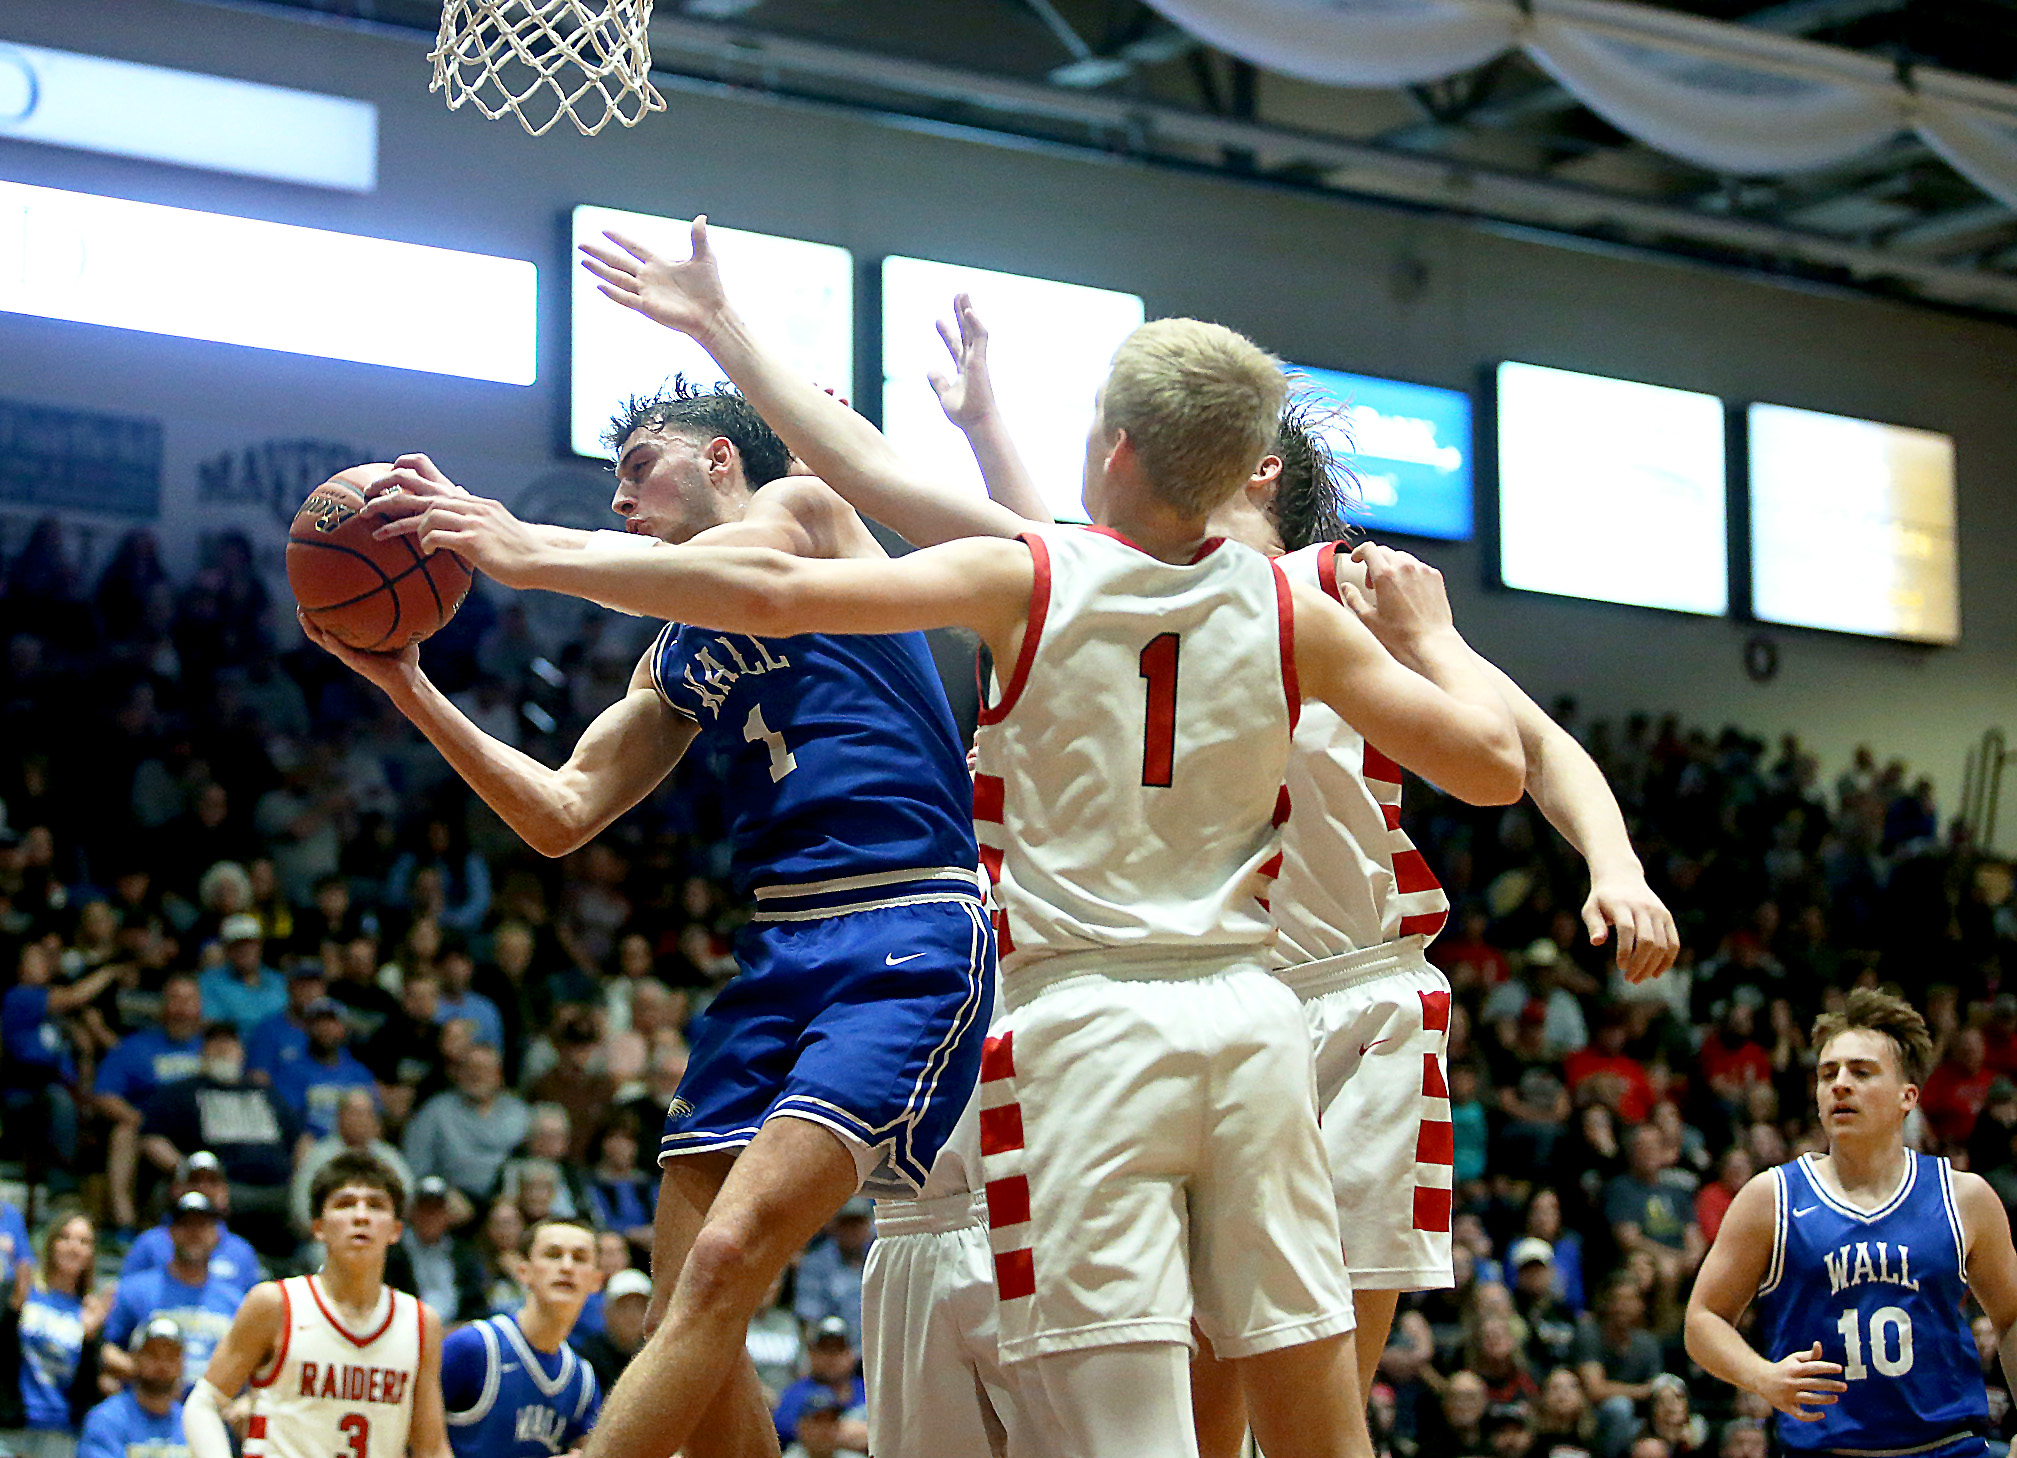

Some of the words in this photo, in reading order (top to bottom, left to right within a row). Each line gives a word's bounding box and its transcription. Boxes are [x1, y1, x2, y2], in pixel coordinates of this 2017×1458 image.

[742, 702, 798, 784] 1
[1139, 631, 1181, 789] 1
[1823, 1241, 1920, 1297] WALL
[1837, 1306, 1914, 1381] 10
[336, 1411, 370, 1458] 3
